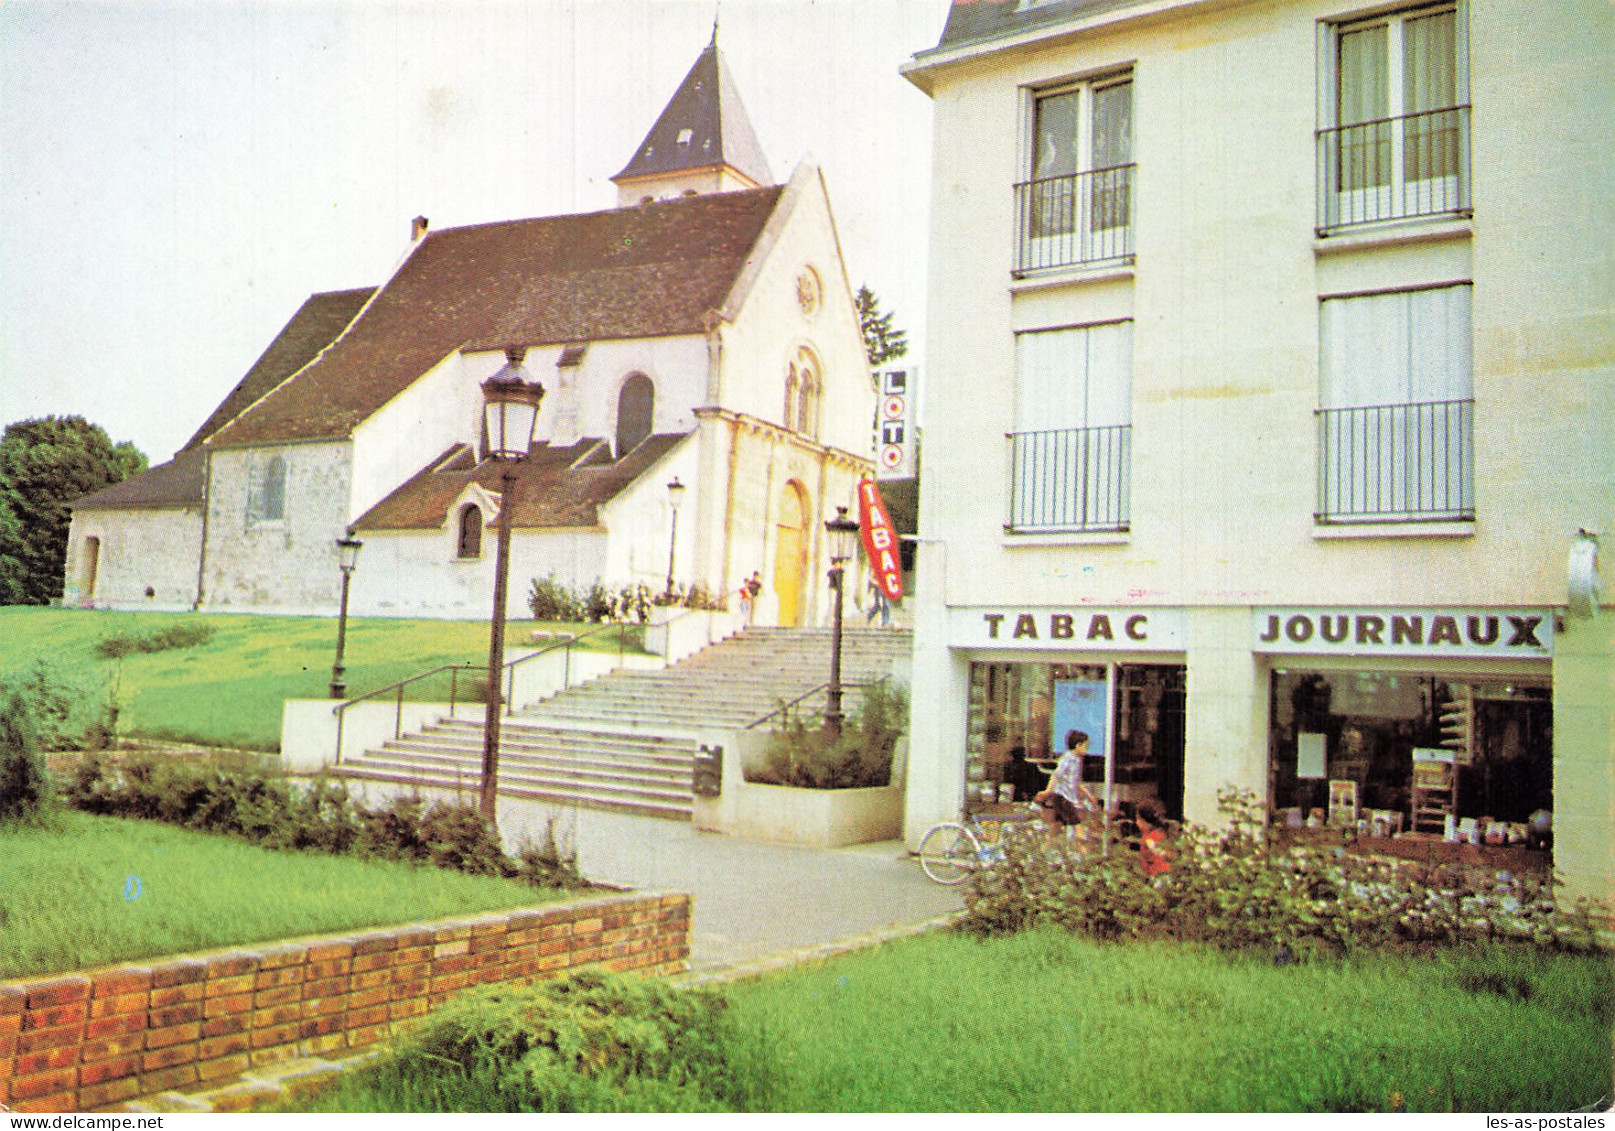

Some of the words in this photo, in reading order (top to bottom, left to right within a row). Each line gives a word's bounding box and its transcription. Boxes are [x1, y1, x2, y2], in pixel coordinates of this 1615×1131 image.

[882, 371, 906, 470] LOTO
[863, 483, 899, 593] TABAC
[984, 613, 1148, 640] TABAC
[1259, 614, 1543, 647] JOURNAUX
